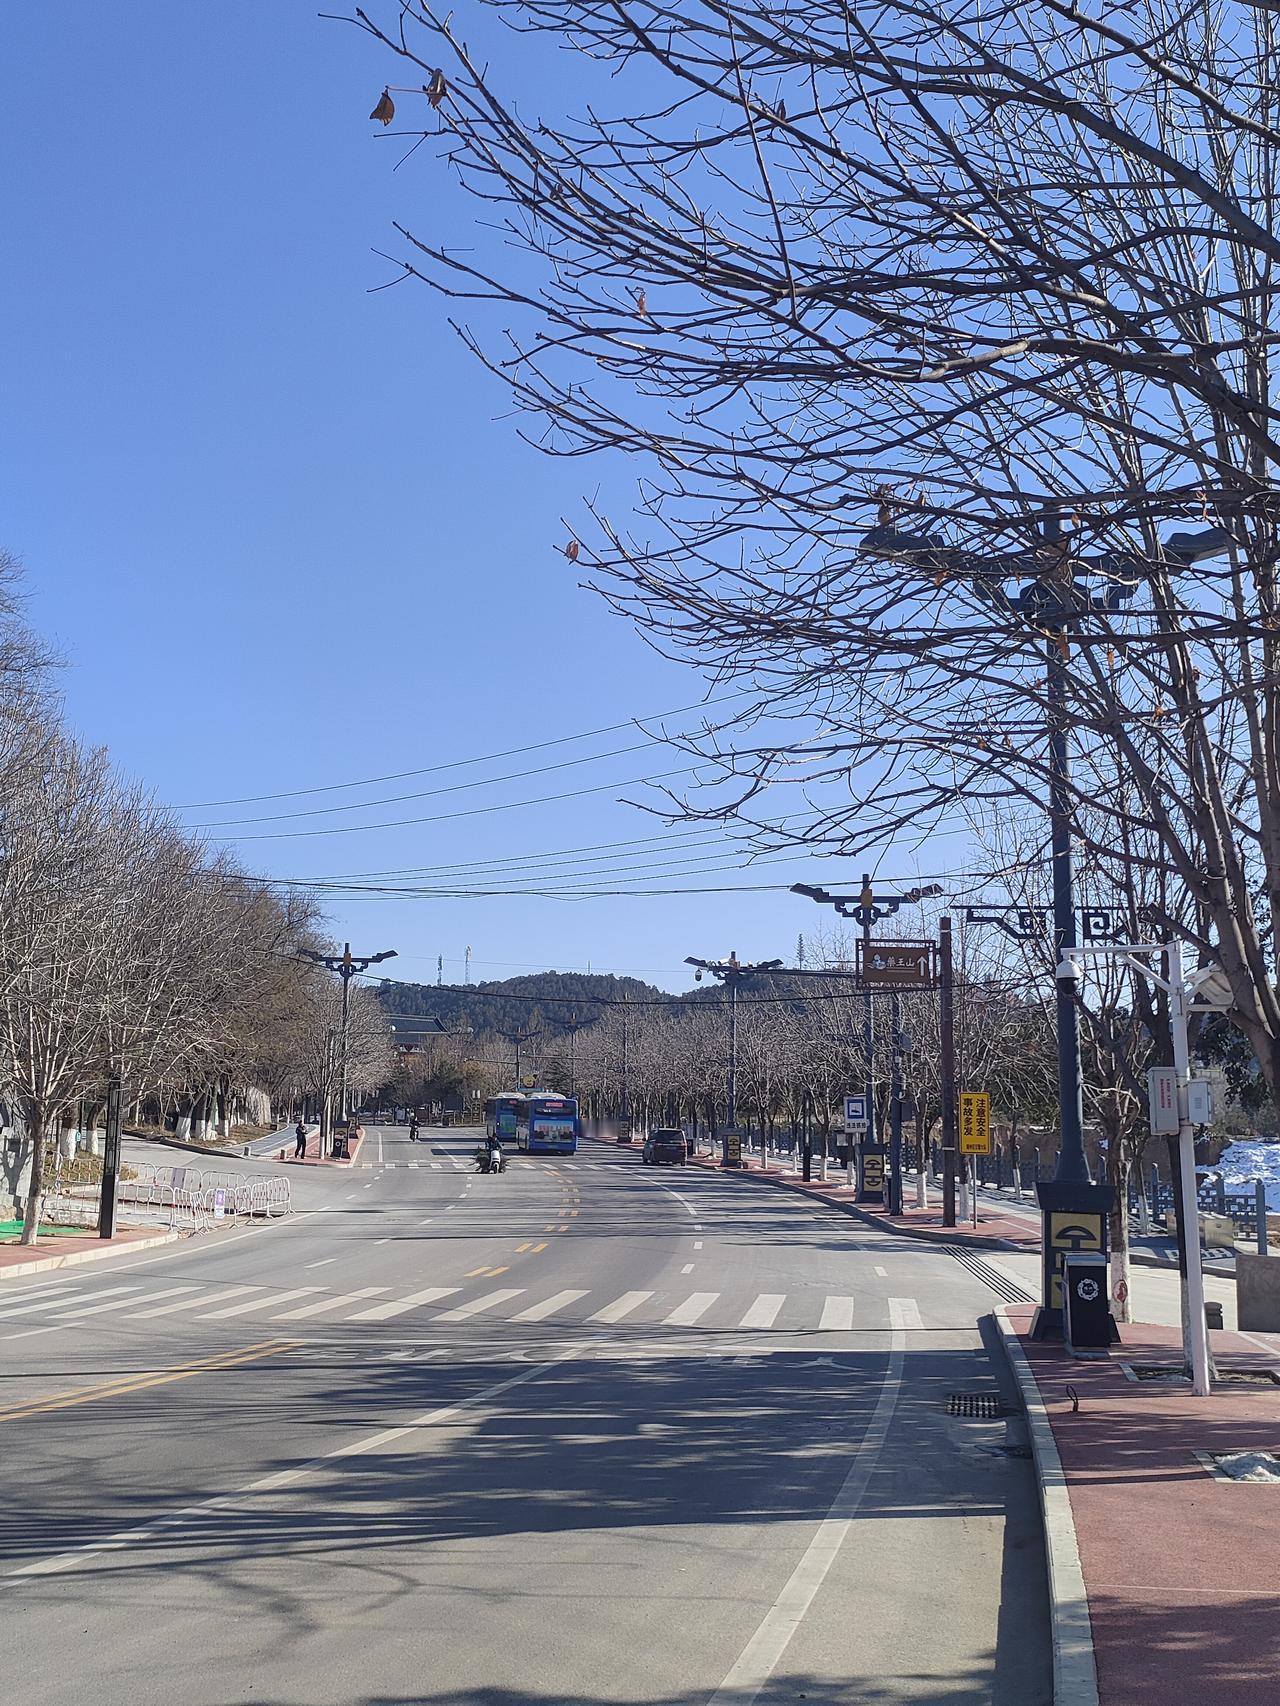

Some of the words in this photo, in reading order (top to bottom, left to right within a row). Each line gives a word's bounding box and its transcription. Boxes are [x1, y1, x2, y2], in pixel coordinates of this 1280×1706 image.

[963, 1097, 973, 1136] 事故多发
[976, 1098, 986, 1137] 注意安全
